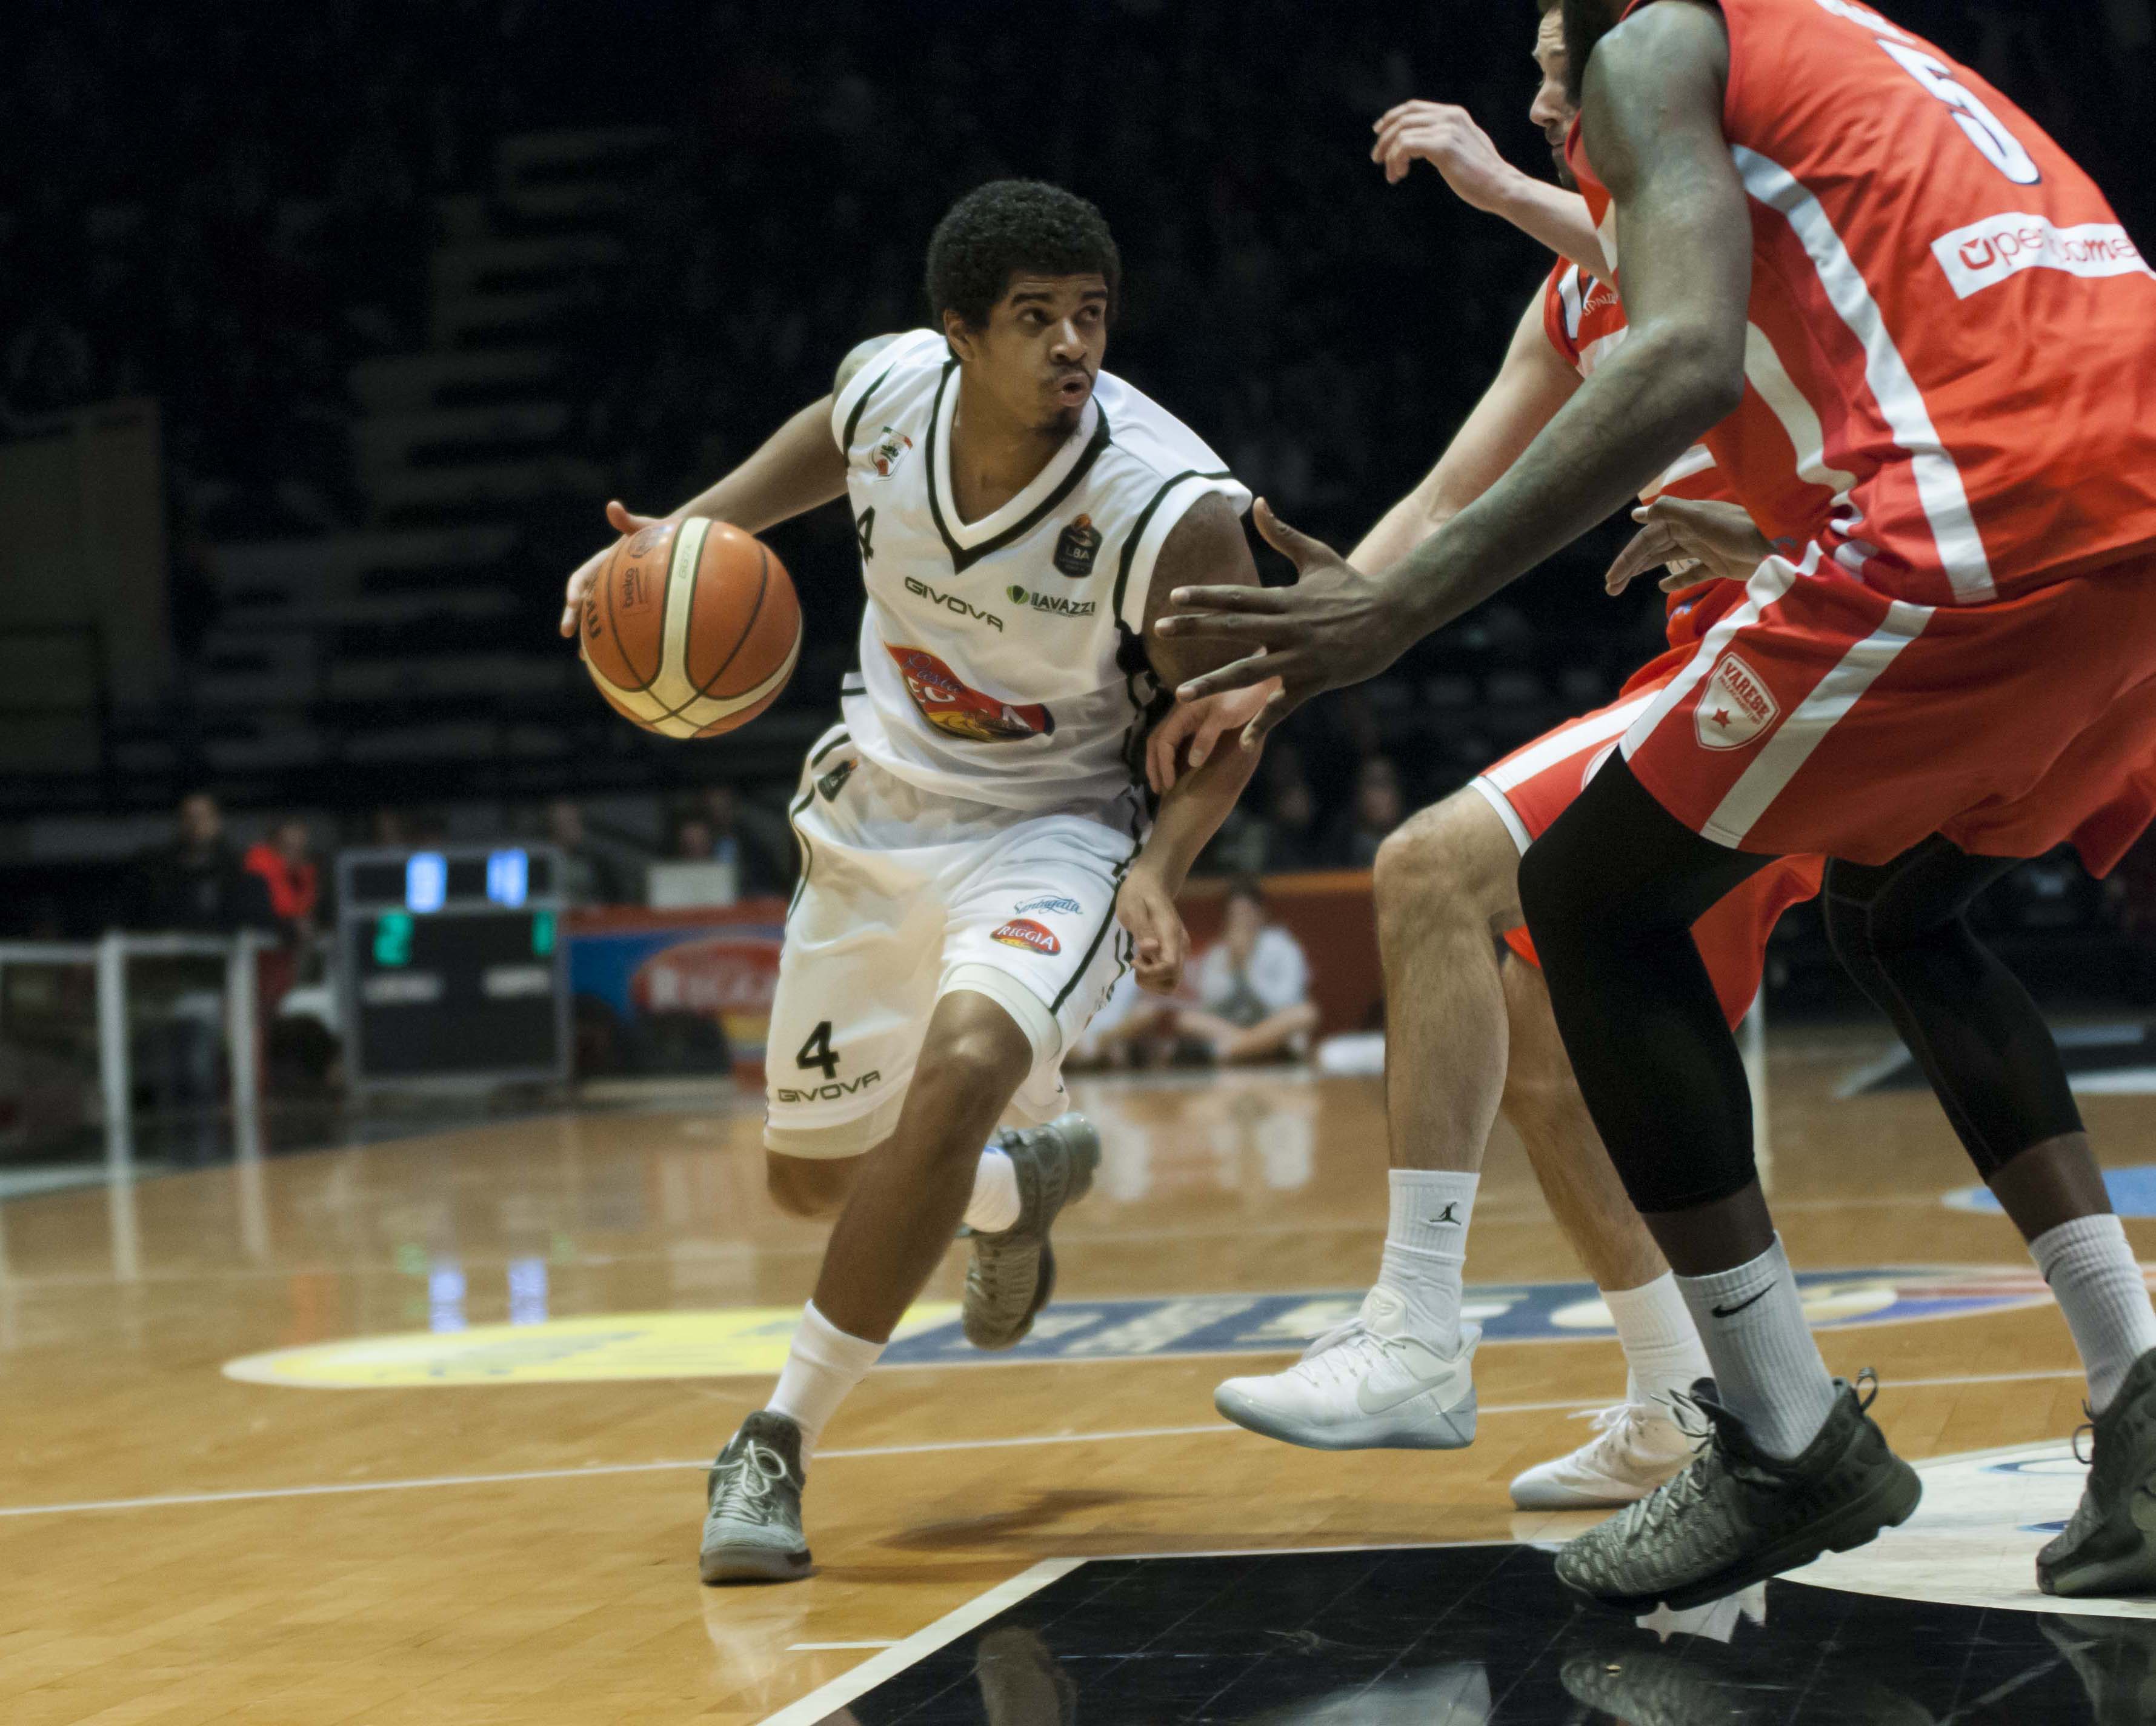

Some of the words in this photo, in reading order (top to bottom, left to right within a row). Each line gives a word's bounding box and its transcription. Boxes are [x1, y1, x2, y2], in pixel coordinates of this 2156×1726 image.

[1876, 38, 2041, 185] 5
[857, 505, 876, 561] 4
[905, 576, 1003, 633] GIVOVA
[997, 925, 1054, 950] REGGIA
[796, 1021, 840, 1079] 4
[777, 1070, 881, 1102] GIVOVA
